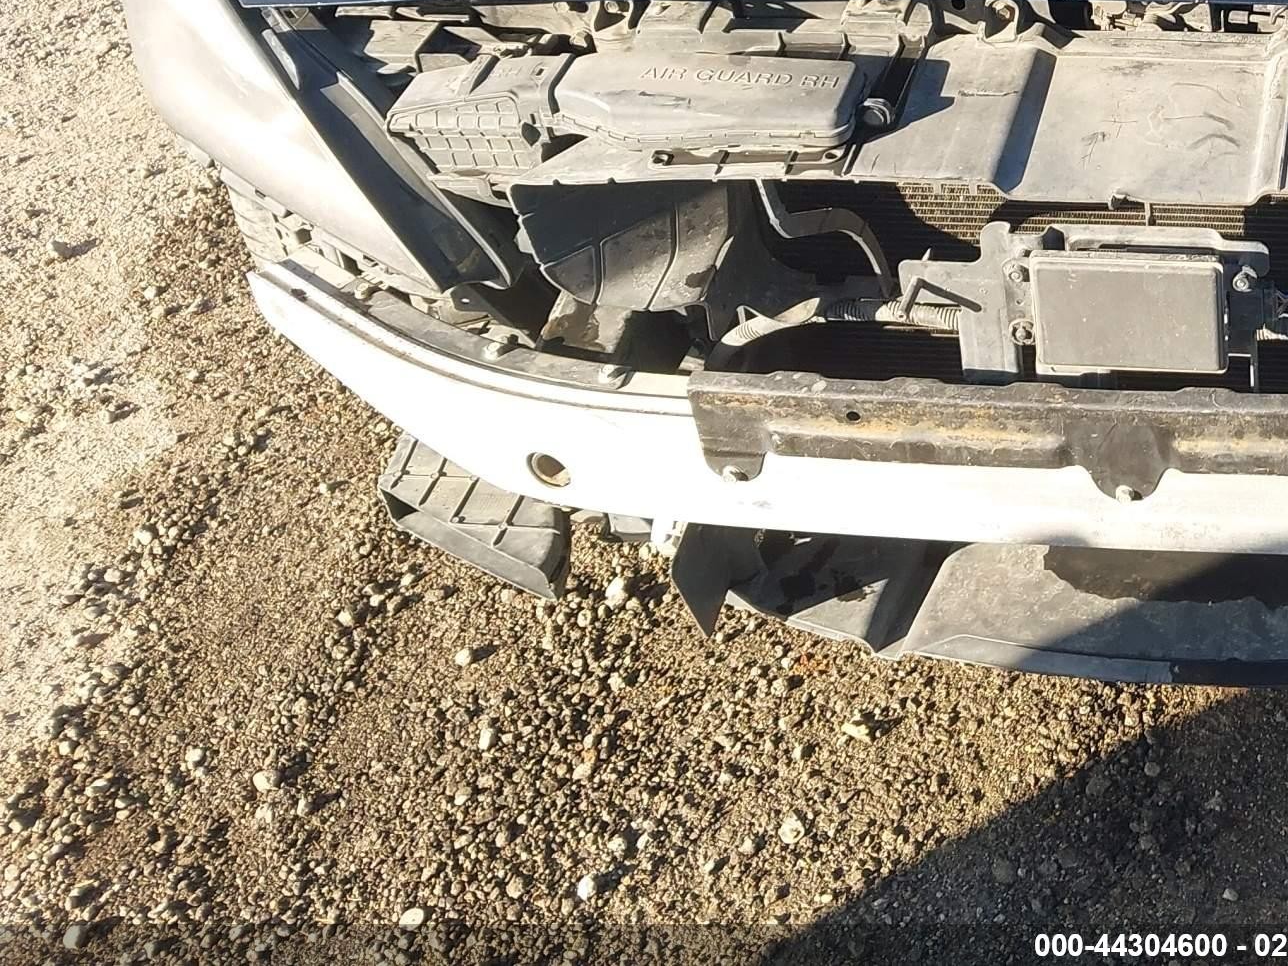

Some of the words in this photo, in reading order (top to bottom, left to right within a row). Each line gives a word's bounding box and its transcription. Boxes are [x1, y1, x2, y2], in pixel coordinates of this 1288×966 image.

[640, 67, 687, 81] AIR
[696, 68, 793, 86] GUARD
[799, 74, 840, 90] RH
